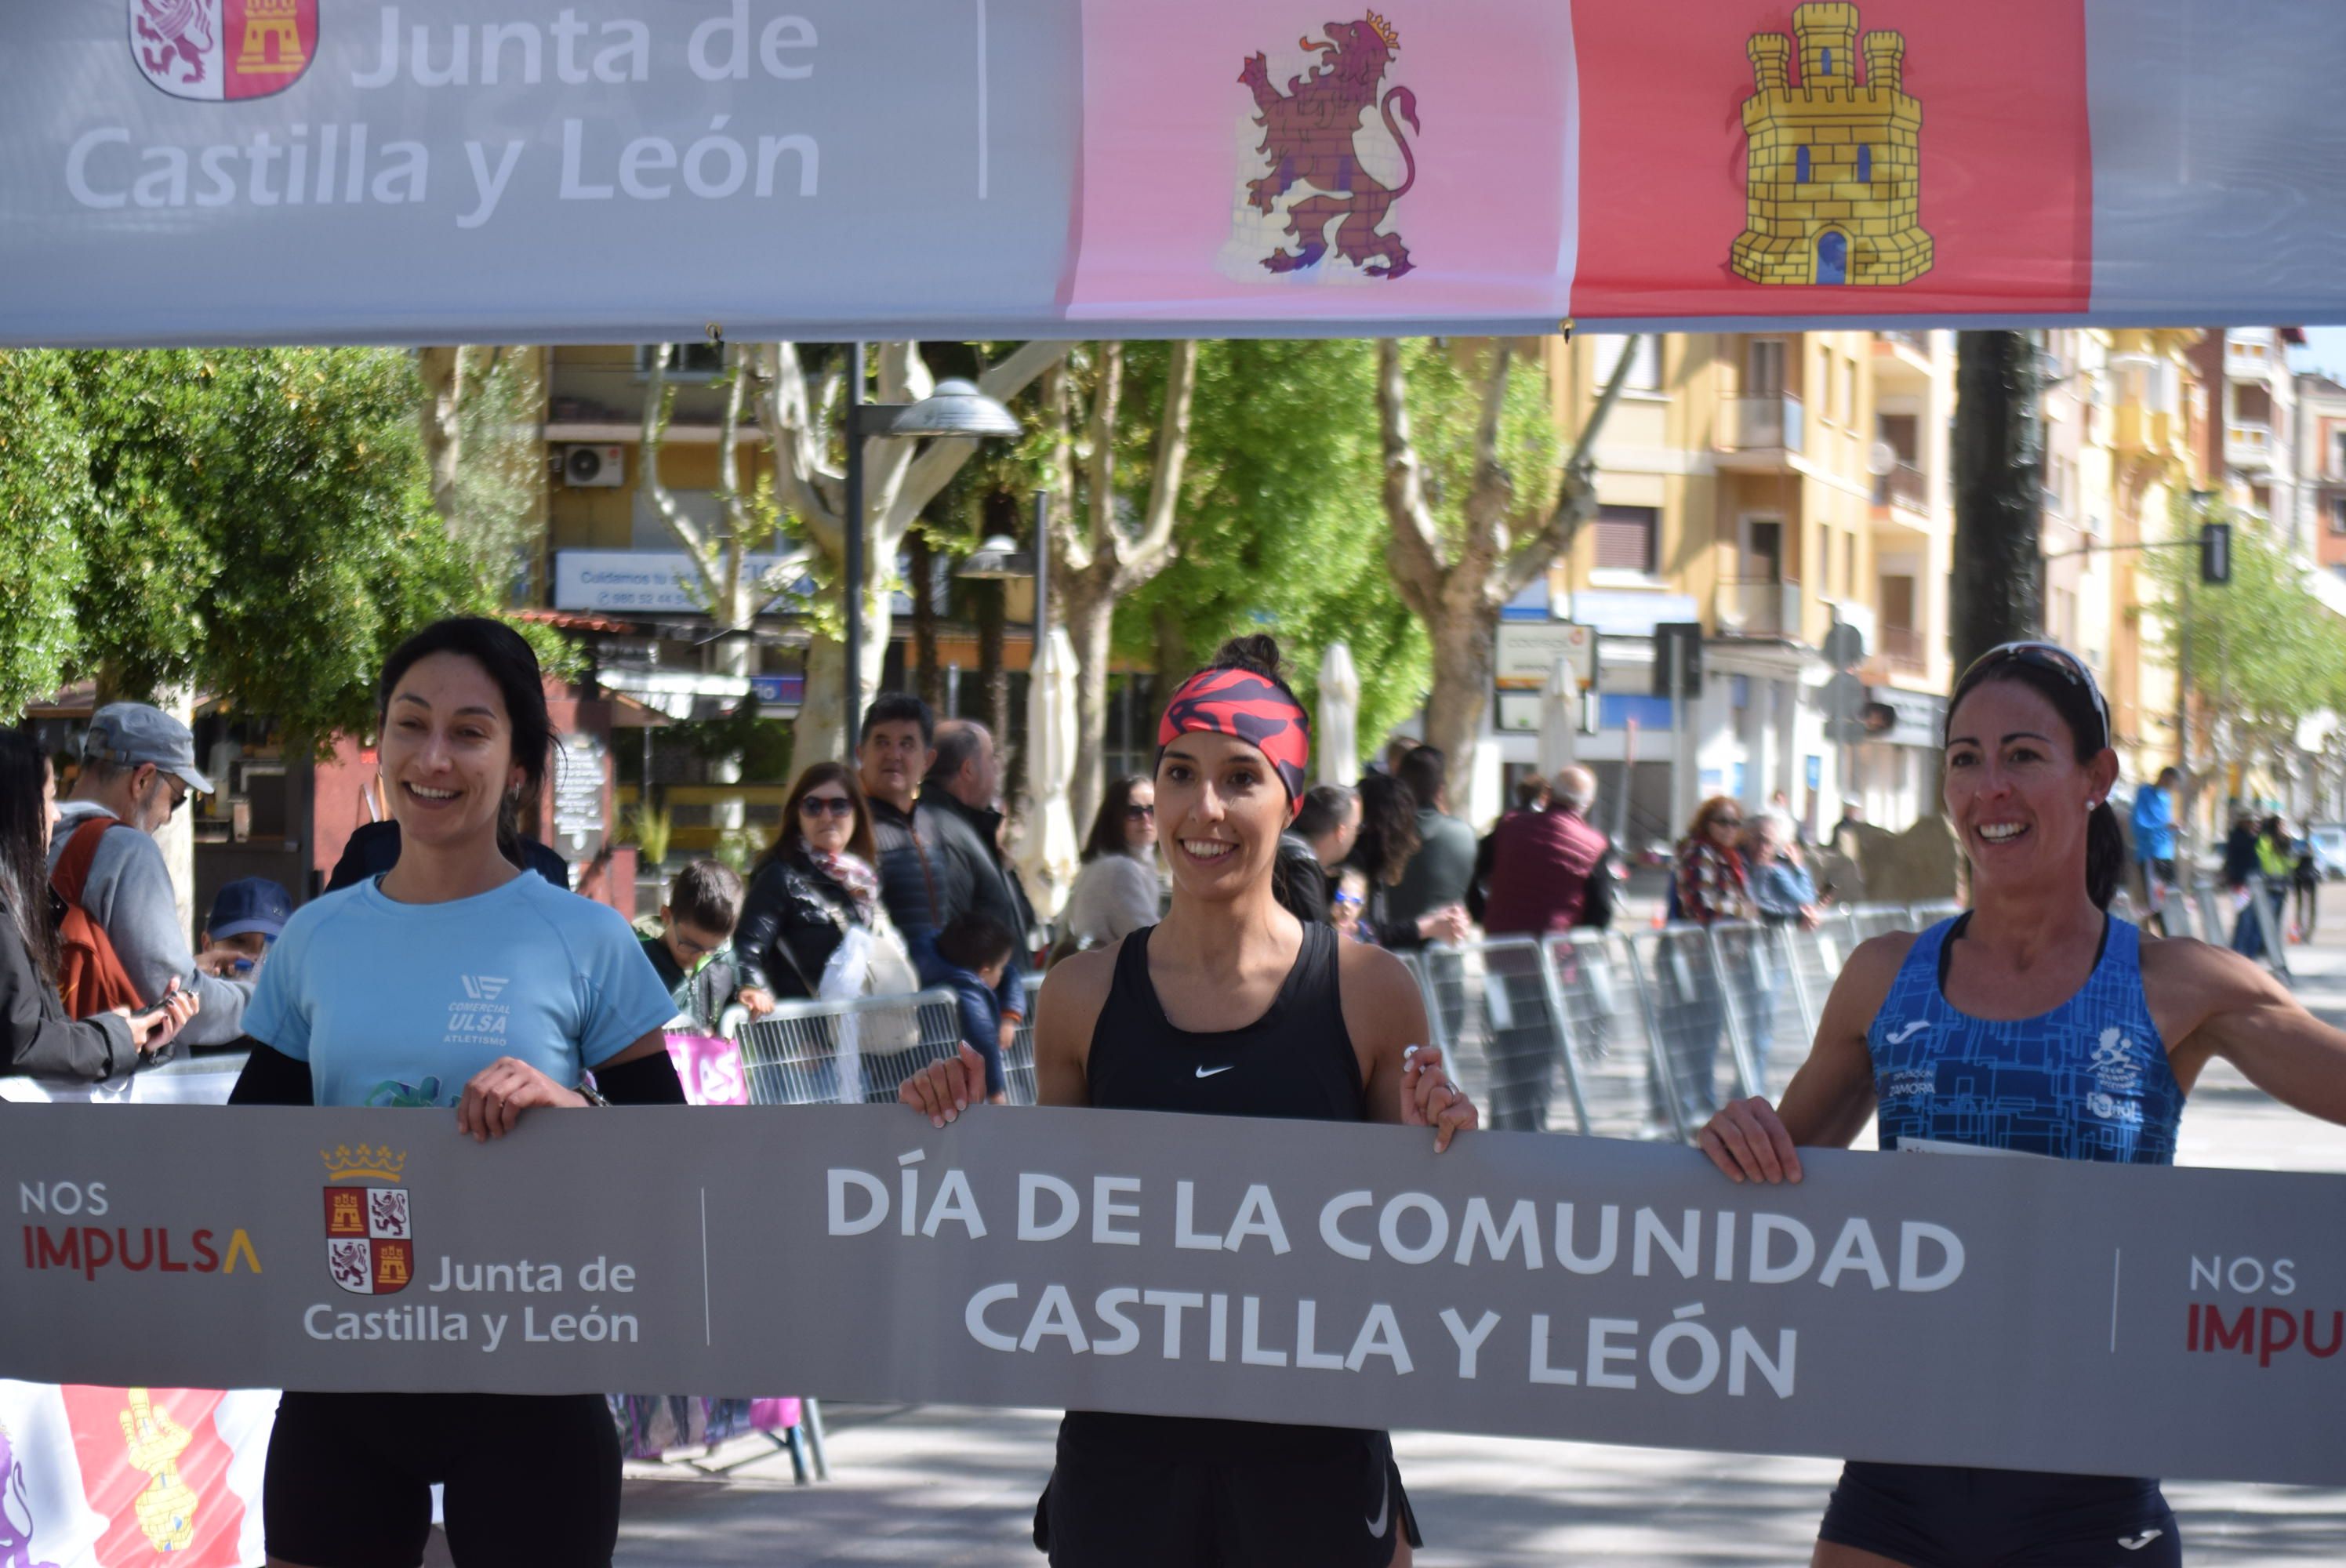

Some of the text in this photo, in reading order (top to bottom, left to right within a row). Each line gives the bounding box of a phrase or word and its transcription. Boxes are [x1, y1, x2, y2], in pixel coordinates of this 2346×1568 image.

[350, 0, 819, 89] Junta de
[65, 114, 820, 228] Castilla y León
[448, 1001, 510, 1014] COMERCIAL
[448, 1013, 507, 1034] ULSA
[443, 1034, 507, 1047] ATLETISMO
[1888, 1083, 1937, 1097] ZAMORA
[19, 1181, 109, 1216] NOS
[827, 1149, 1966, 1293] DÍA DE LA COMUNIDAD
[24, 1225, 263, 1282] IMPULSA
[428, 1255, 637, 1294] Junta de
[2190, 1255, 2296, 1296] NOS
[303, 1303, 639, 1352] Castilla y León
[964, 1283, 1798, 1399] CASTILLA Y LEÓN
